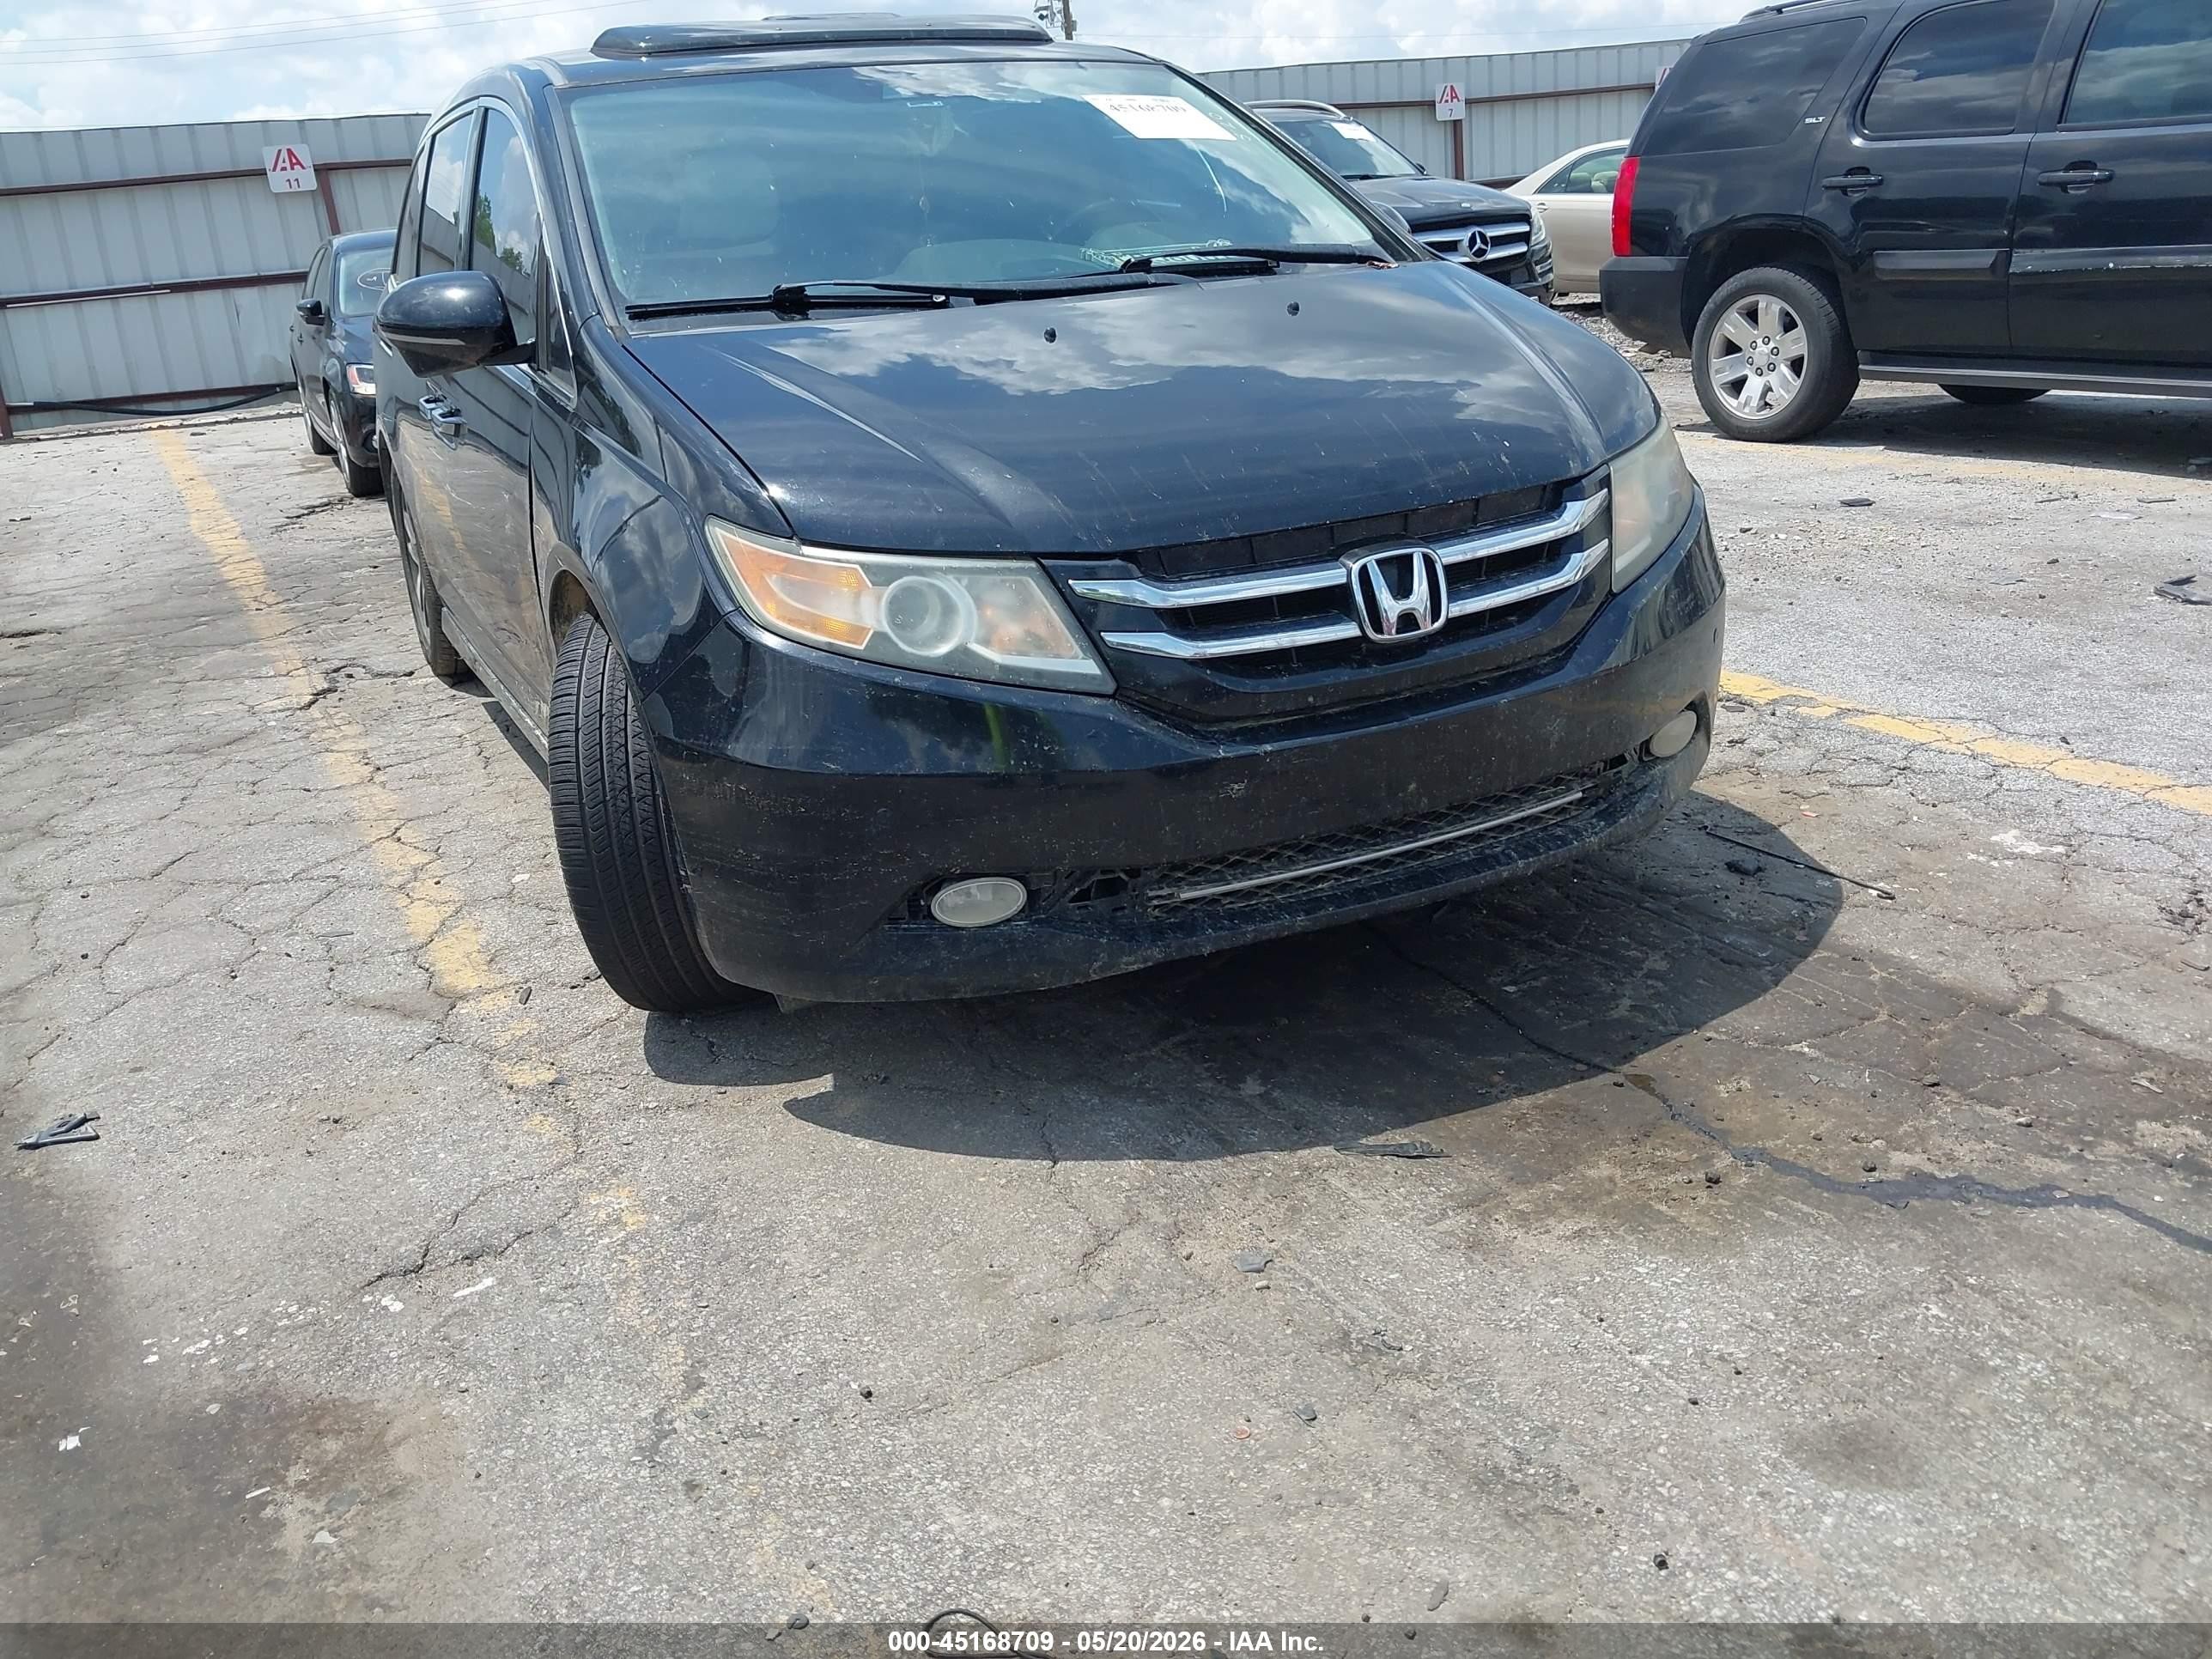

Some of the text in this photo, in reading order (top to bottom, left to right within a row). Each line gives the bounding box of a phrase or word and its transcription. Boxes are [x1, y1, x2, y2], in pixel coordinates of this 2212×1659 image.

[1449, 108, 1454, 118] 7
[1804, 116, 1826, 125] SLT
[285, 178, 301, 189] 11
